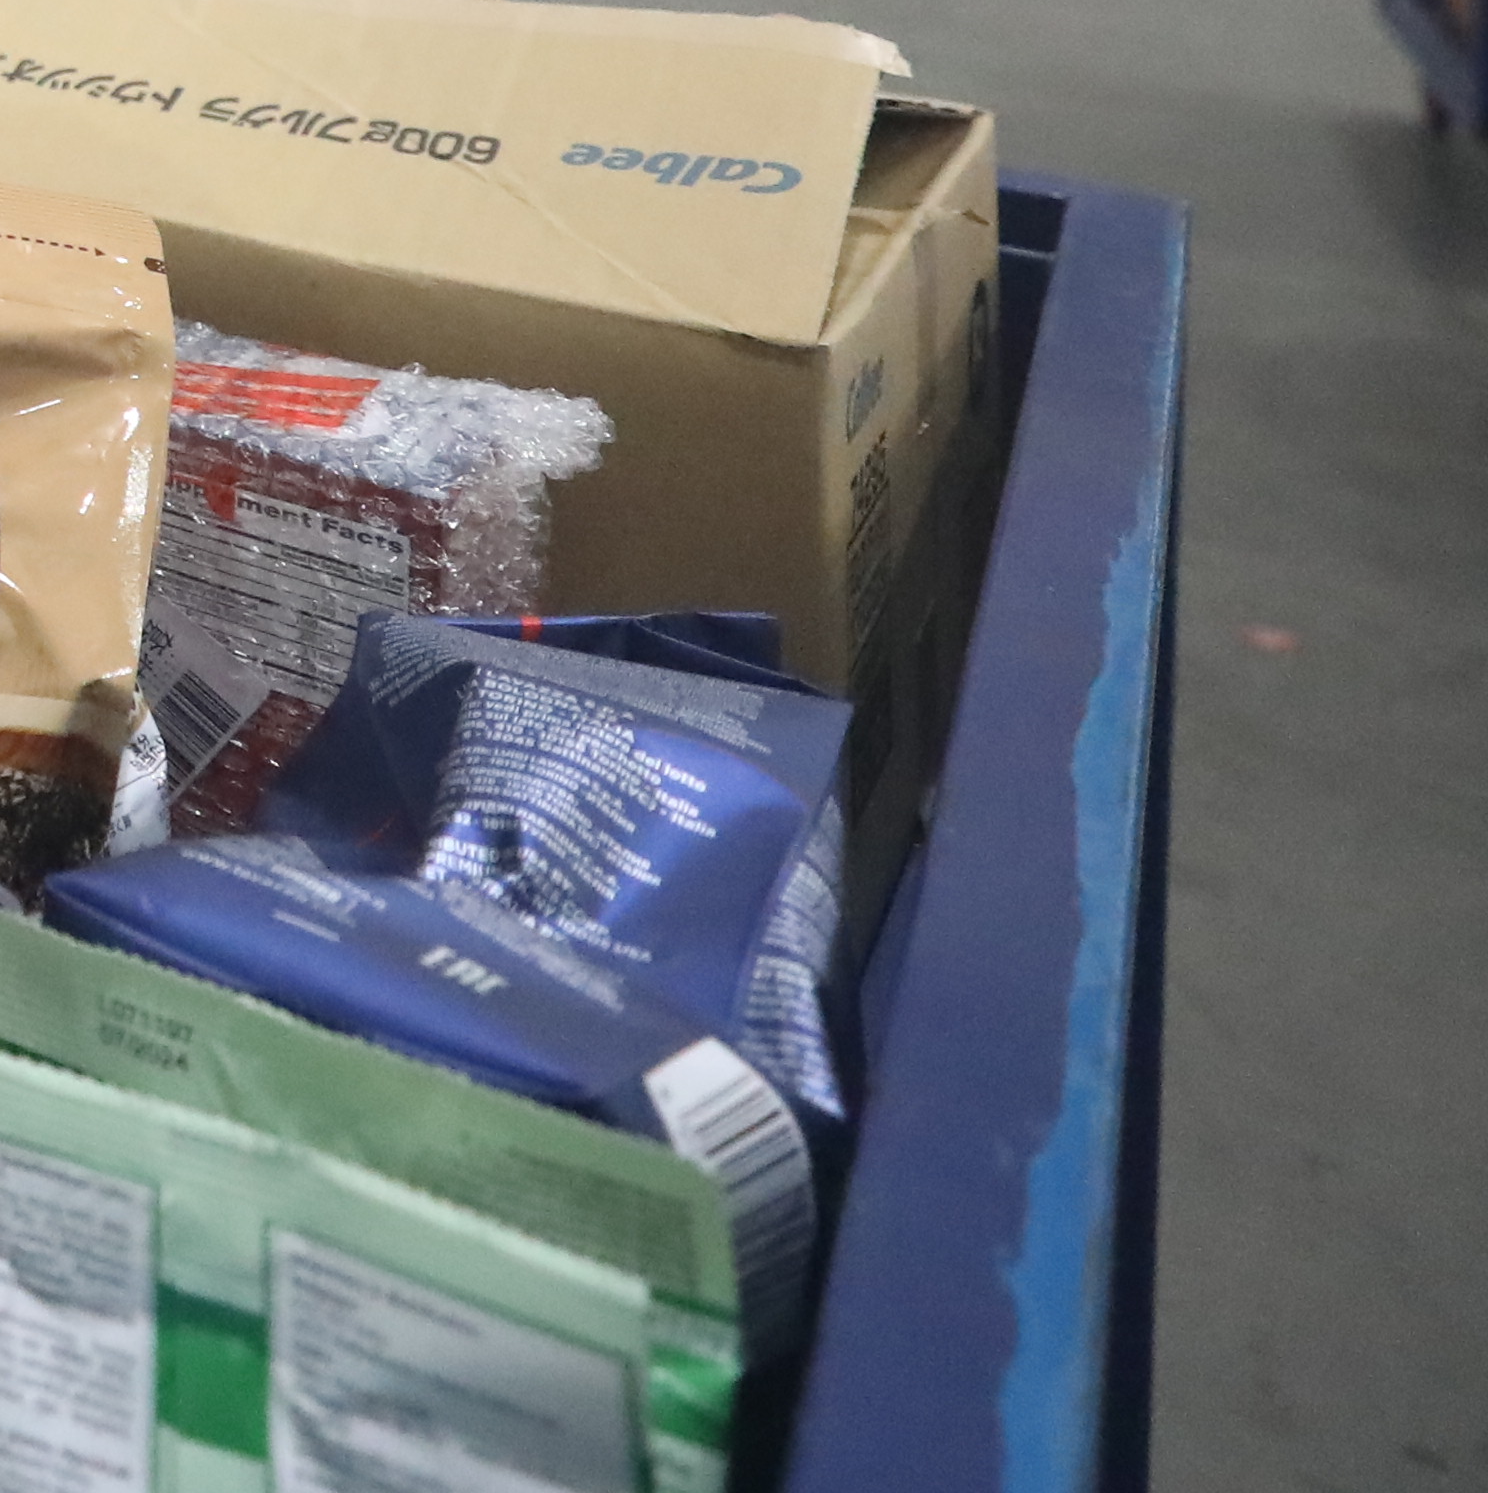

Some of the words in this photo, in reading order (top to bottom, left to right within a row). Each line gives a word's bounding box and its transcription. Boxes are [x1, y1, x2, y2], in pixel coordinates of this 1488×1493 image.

[558, 140, 799, 198] Calbee
[322, 517, 405, 554] Facts
[664, 762, 707, 793] lotto
